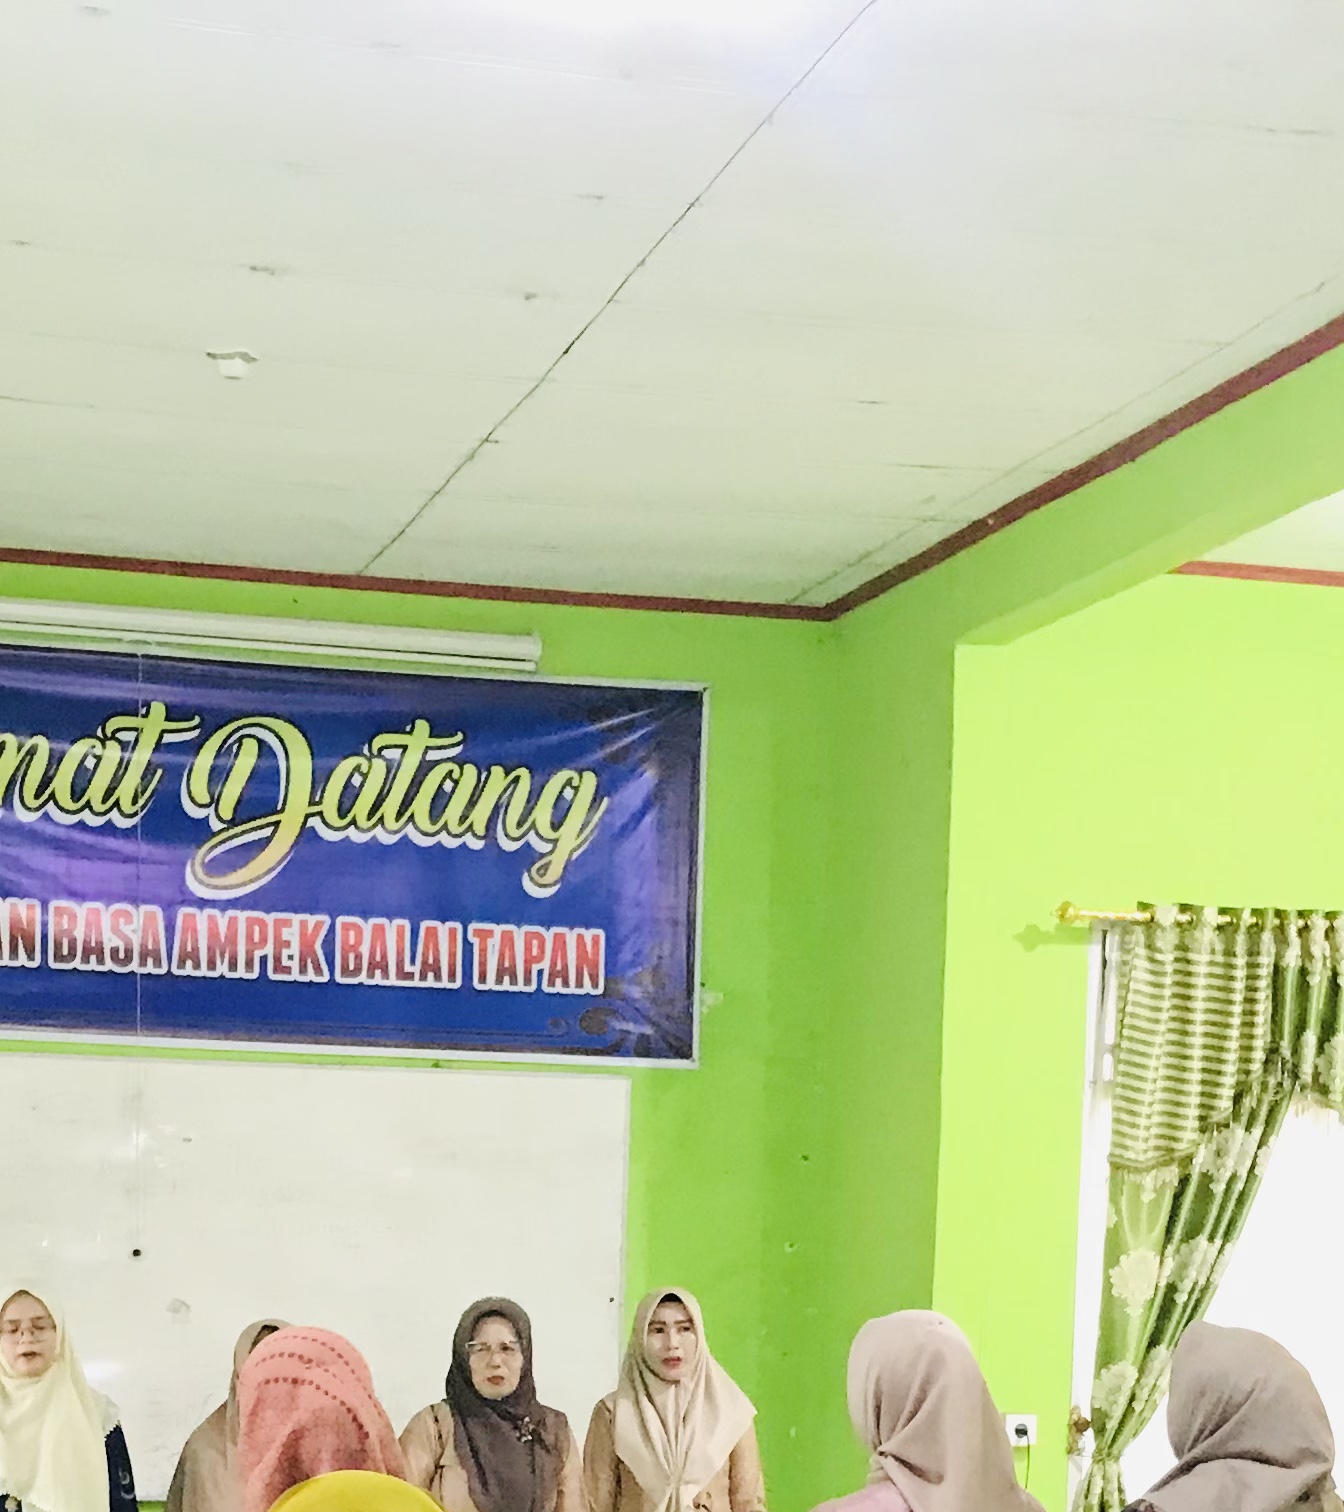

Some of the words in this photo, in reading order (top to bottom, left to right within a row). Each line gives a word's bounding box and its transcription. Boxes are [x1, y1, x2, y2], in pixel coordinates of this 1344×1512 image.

[180, 715, 608, 899] Datang
[48, 900, 168, 974] BASA
[173, 906, 330, 982] AMPEK
[335, 915, 462, 989] BALAI
[468, 923, 605, 995] TAPAN
